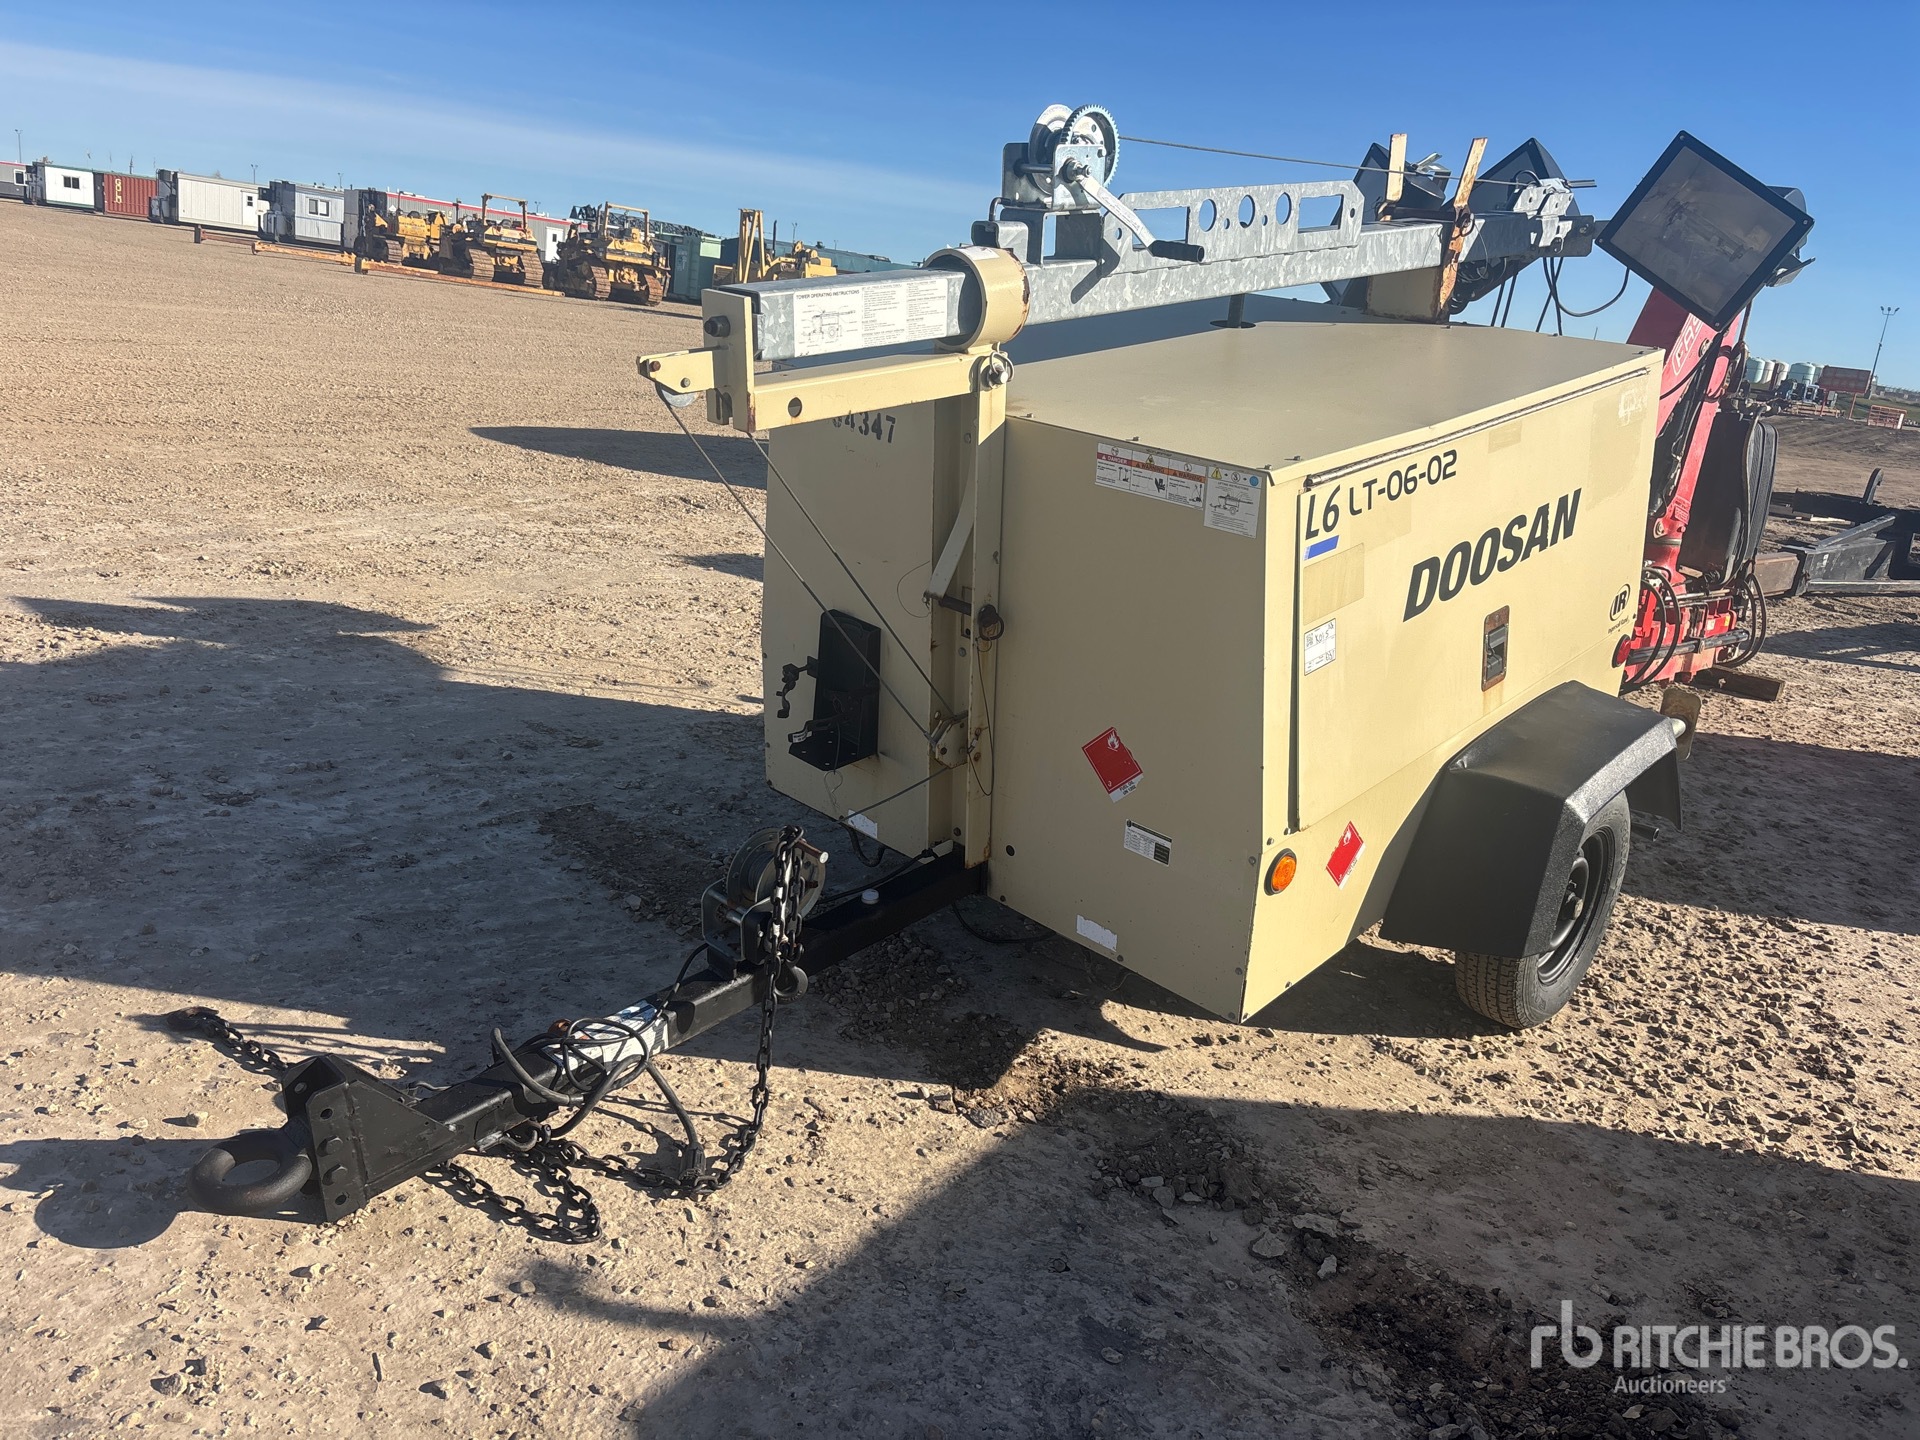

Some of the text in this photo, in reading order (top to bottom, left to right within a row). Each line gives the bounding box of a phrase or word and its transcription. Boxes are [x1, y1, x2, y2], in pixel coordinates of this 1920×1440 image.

[811, 291, 832, 299] OPERATING
[832, 289, 860, 297] INSTRUCTIONS
[1107, 455, 1128, 465] DANGER
[1141, 463, 1165, 474] WARNING
[1178, 470, 1203, 482] WARNING
[1350, 449, 1458, 516] LT-06-02
[1305, 484, 1341, 540] L6
[1403, 488, 1582, 622] DOOSAN
[1612, 590, 1628, 616] IR
